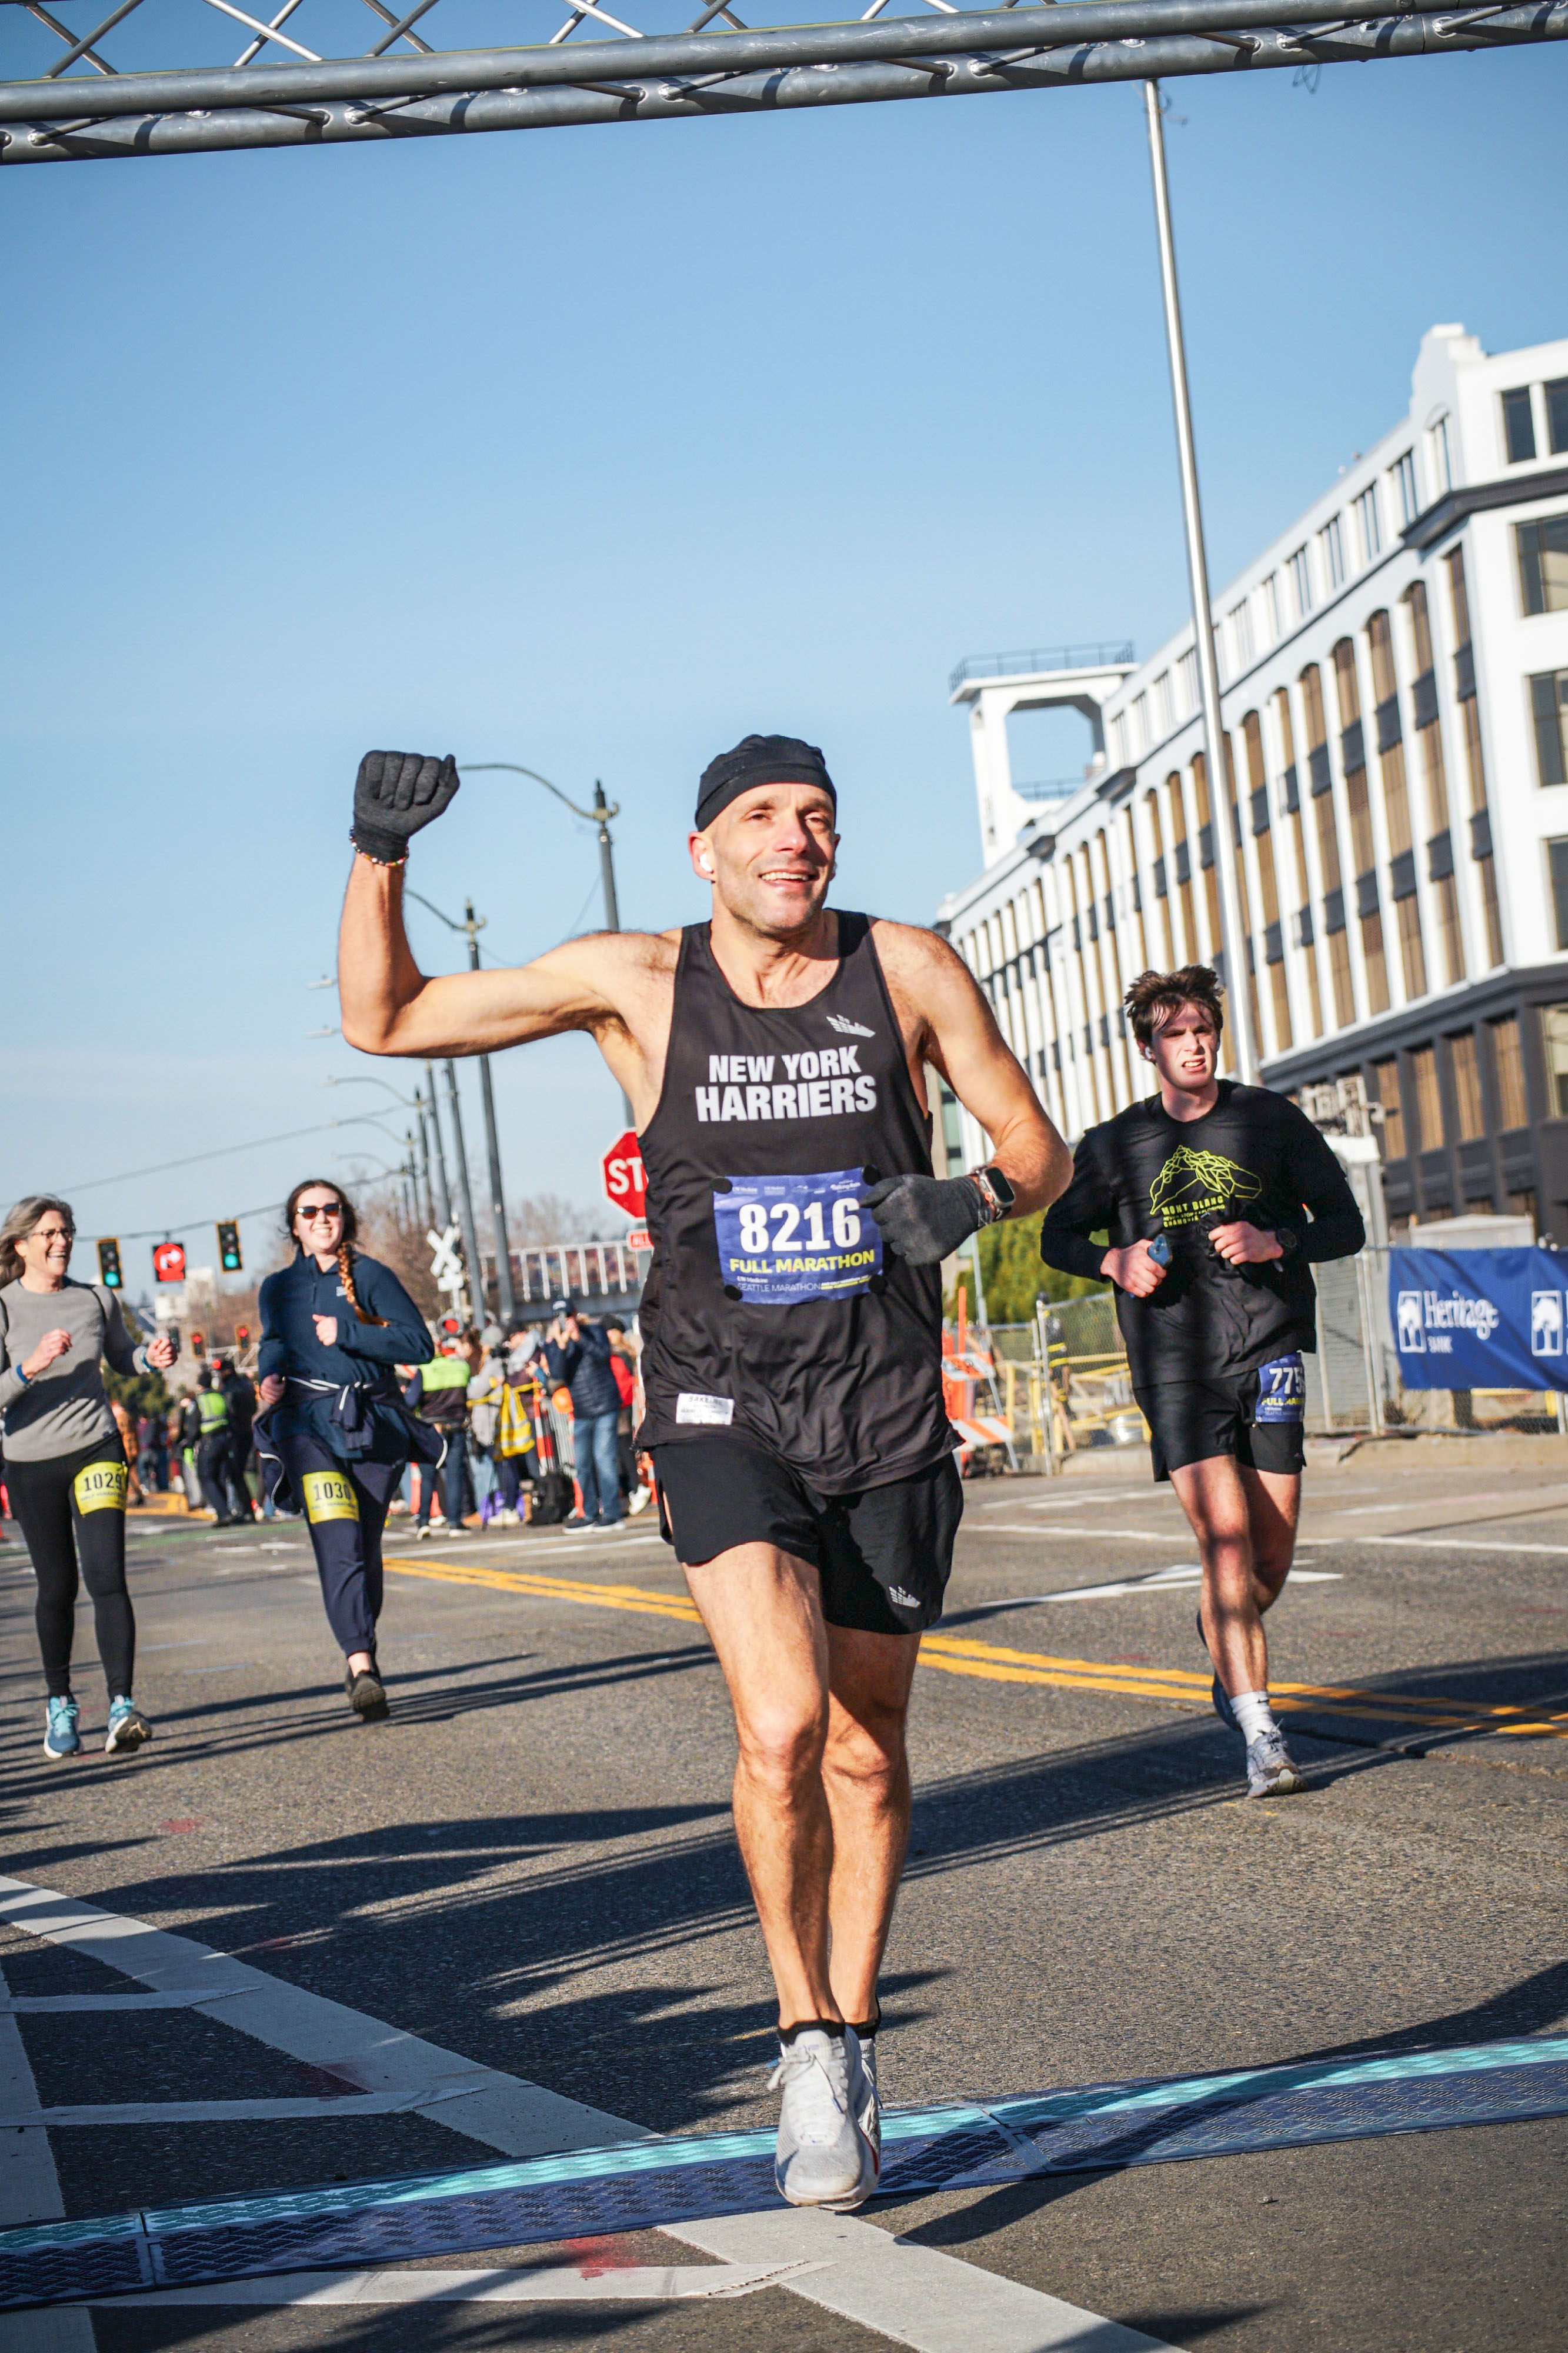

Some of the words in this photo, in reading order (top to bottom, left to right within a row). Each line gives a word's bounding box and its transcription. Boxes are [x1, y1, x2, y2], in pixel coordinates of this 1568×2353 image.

[709, 1055, 775, 1082] NEW
[781, 1045, 861, 1081] YORK
[695, 1075, 876, 1121] HARRIERS
[608, 1156, 649, 1195] ST
[1161, 1203, 1187, 1215] MONT
[739, 1198, 861, 1253] 8216
[730, 1258, 773, 1274] FULL
[776, 1249, 875, 1273] MARATHON
[737, 1283, 769, 1292] SEATTLE
[772, 1282, 821, 1291] MARATHON
[1269, 1367, 1305, 1394] 775
[84, 1472, 123, 1492] 1029
